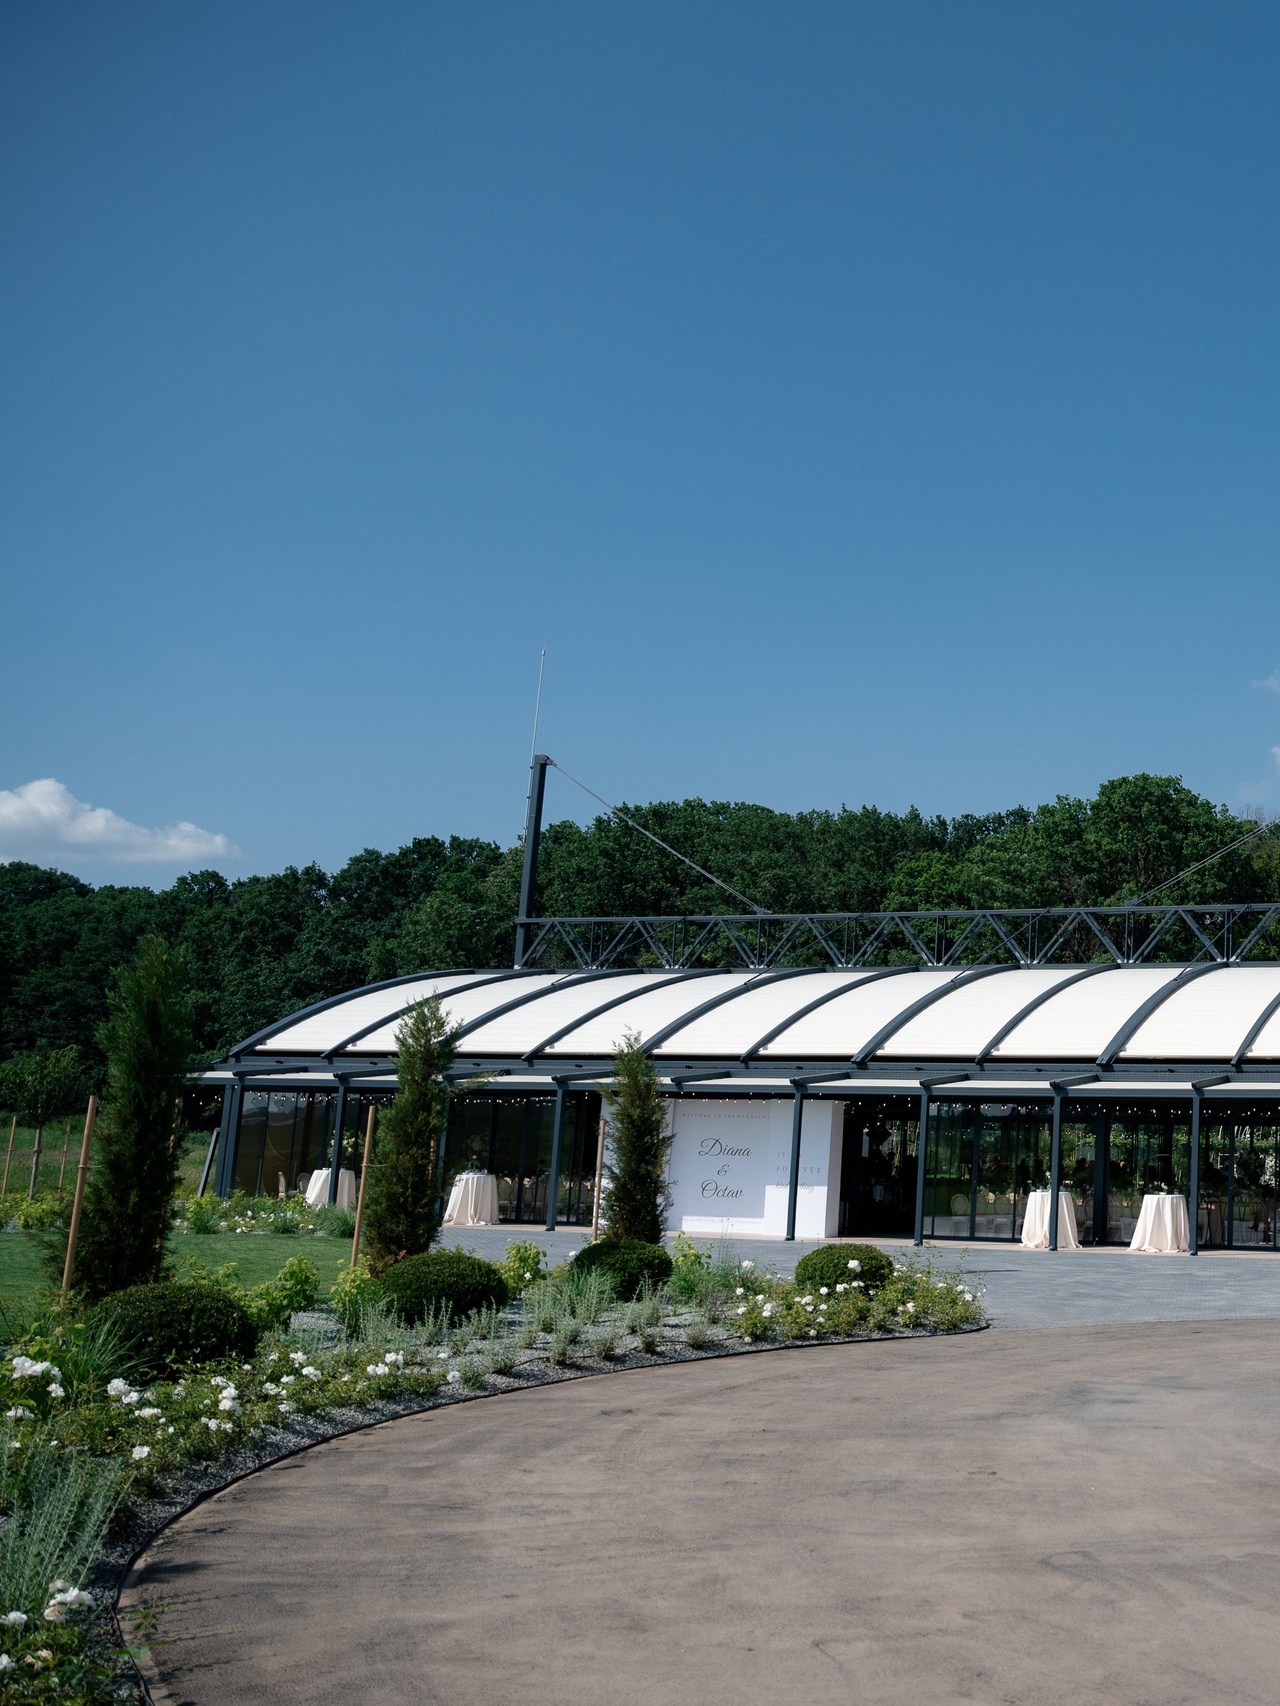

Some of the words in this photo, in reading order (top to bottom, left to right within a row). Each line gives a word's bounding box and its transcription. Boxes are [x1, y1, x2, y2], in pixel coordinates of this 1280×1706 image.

[698, 1137, 752, 1157] Diana
[717, 1164, 731, 1176] &
[776, 1165, 822, 1174] FOVER
[700, 1179, 744, 1199] Octav
